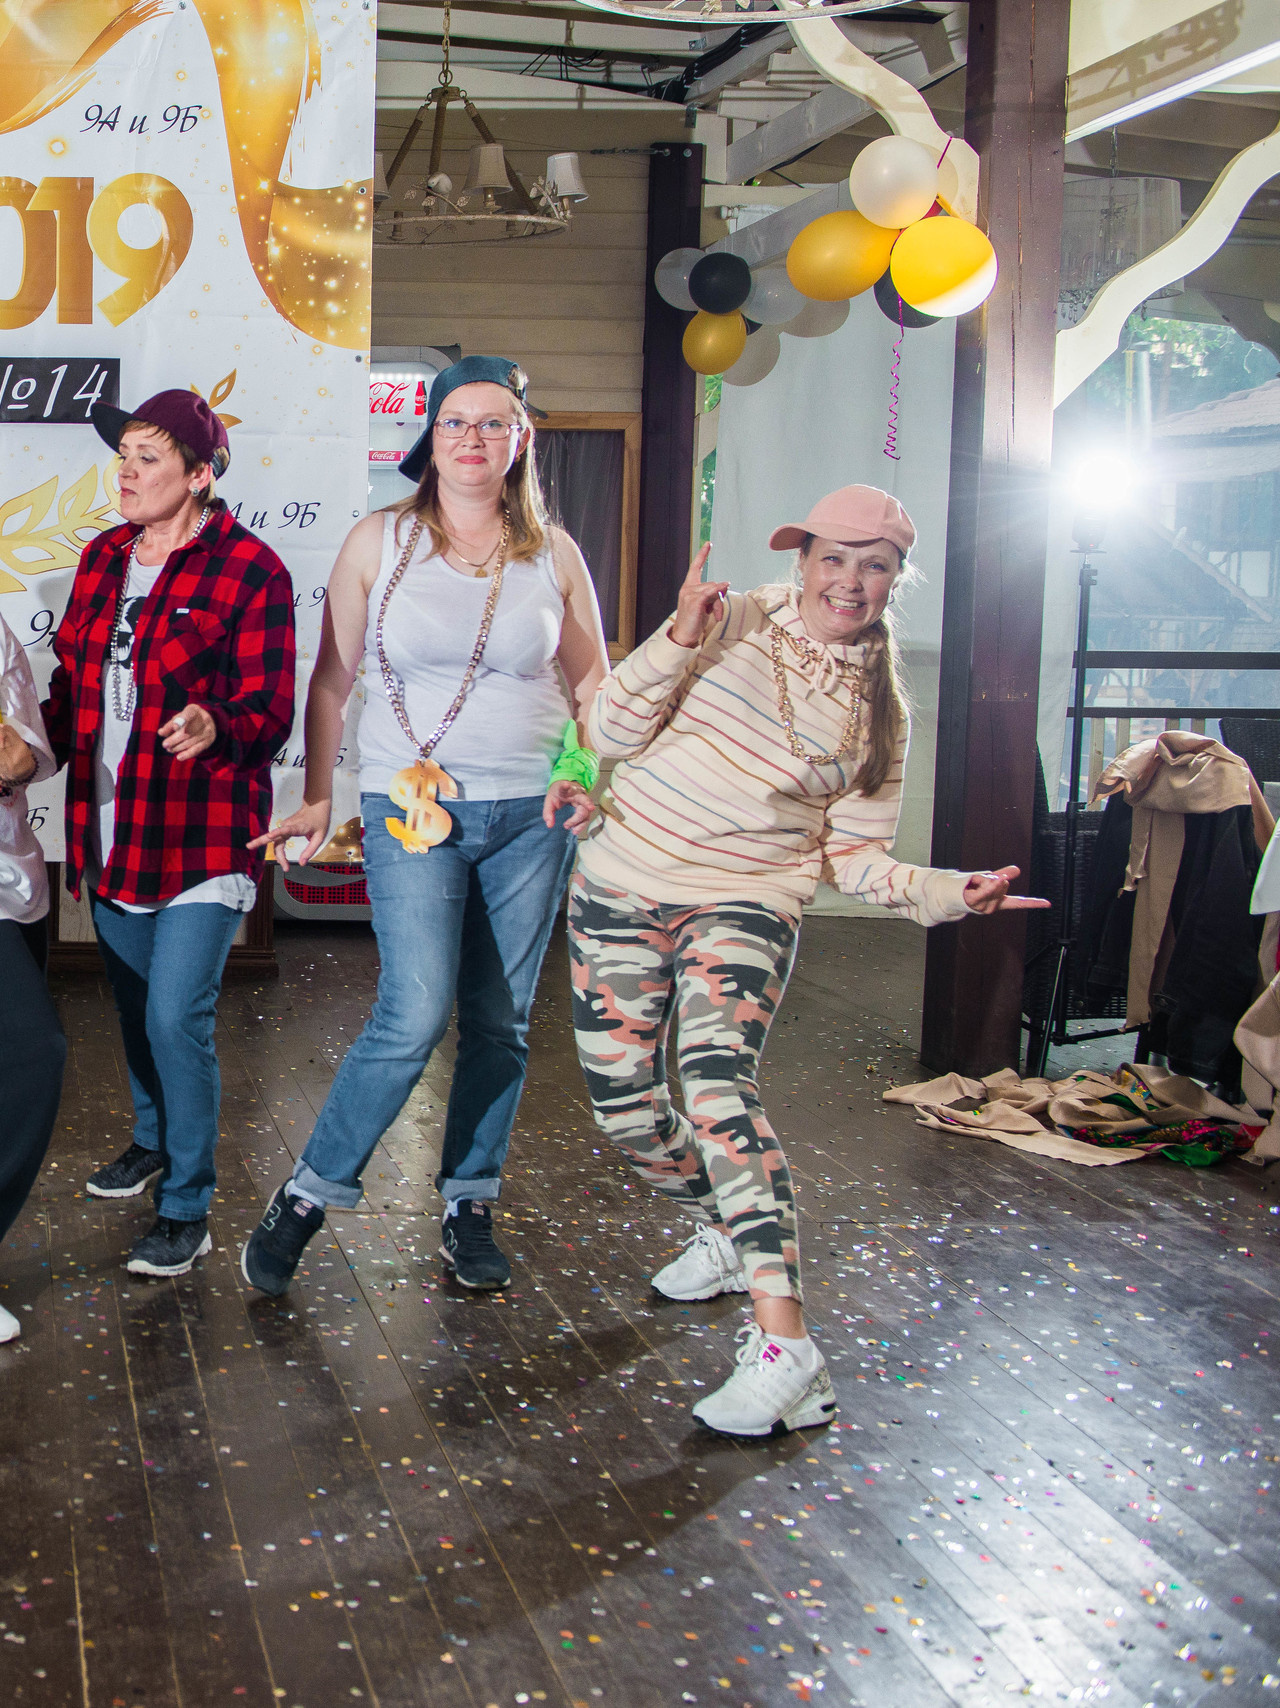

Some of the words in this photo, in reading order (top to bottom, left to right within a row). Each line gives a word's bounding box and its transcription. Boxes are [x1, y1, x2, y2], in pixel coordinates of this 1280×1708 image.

[80, 104, 122, 133] 9А
[129, 115, 150, 134] и
[157, 104, 203, 134] 9Б
[277, 501, 322, 529] 9Б
[308, 586, 328, 608] 9
